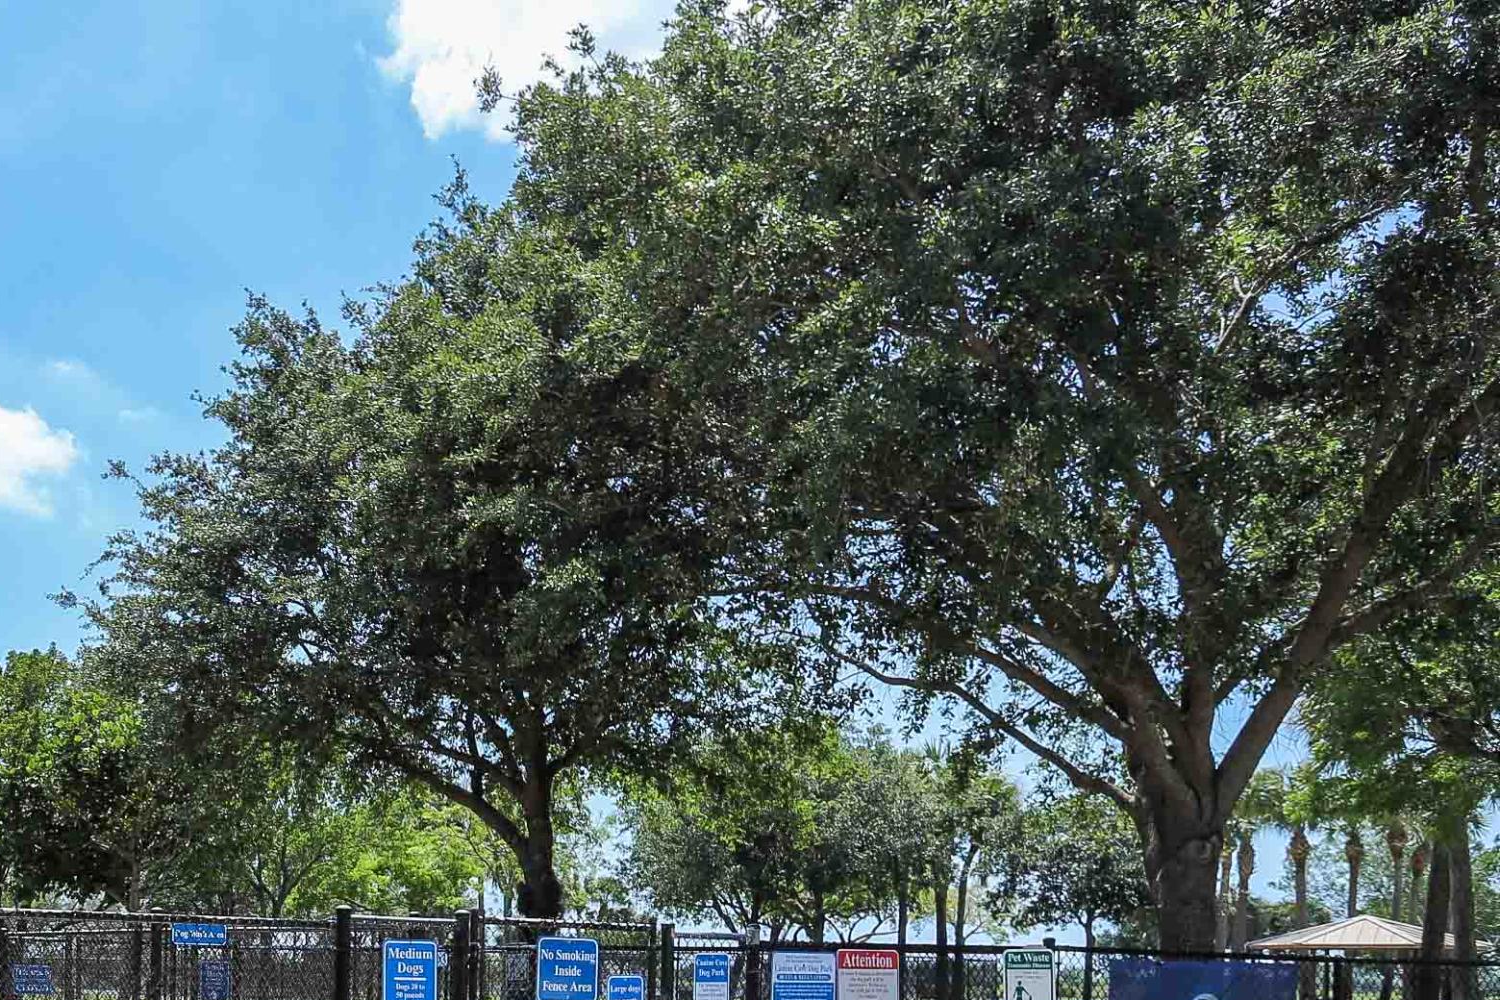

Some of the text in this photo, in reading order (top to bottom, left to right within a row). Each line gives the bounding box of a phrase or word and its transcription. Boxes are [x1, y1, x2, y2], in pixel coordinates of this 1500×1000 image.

[388, 947, 433, 960] Medium
[541, 948, 596, 965] No Smoking
[1008, 953, 1050, 962] Pet Waste
[842, 952, 893, 968] Attention
[397, 961, 424, 976] Dogs
[554, 965, 582, 977] Inside
[396, 983, 410, 992] Dogs
[542, 980, 593, 992] Fence Area
[610, 985, 627, 995] Large
